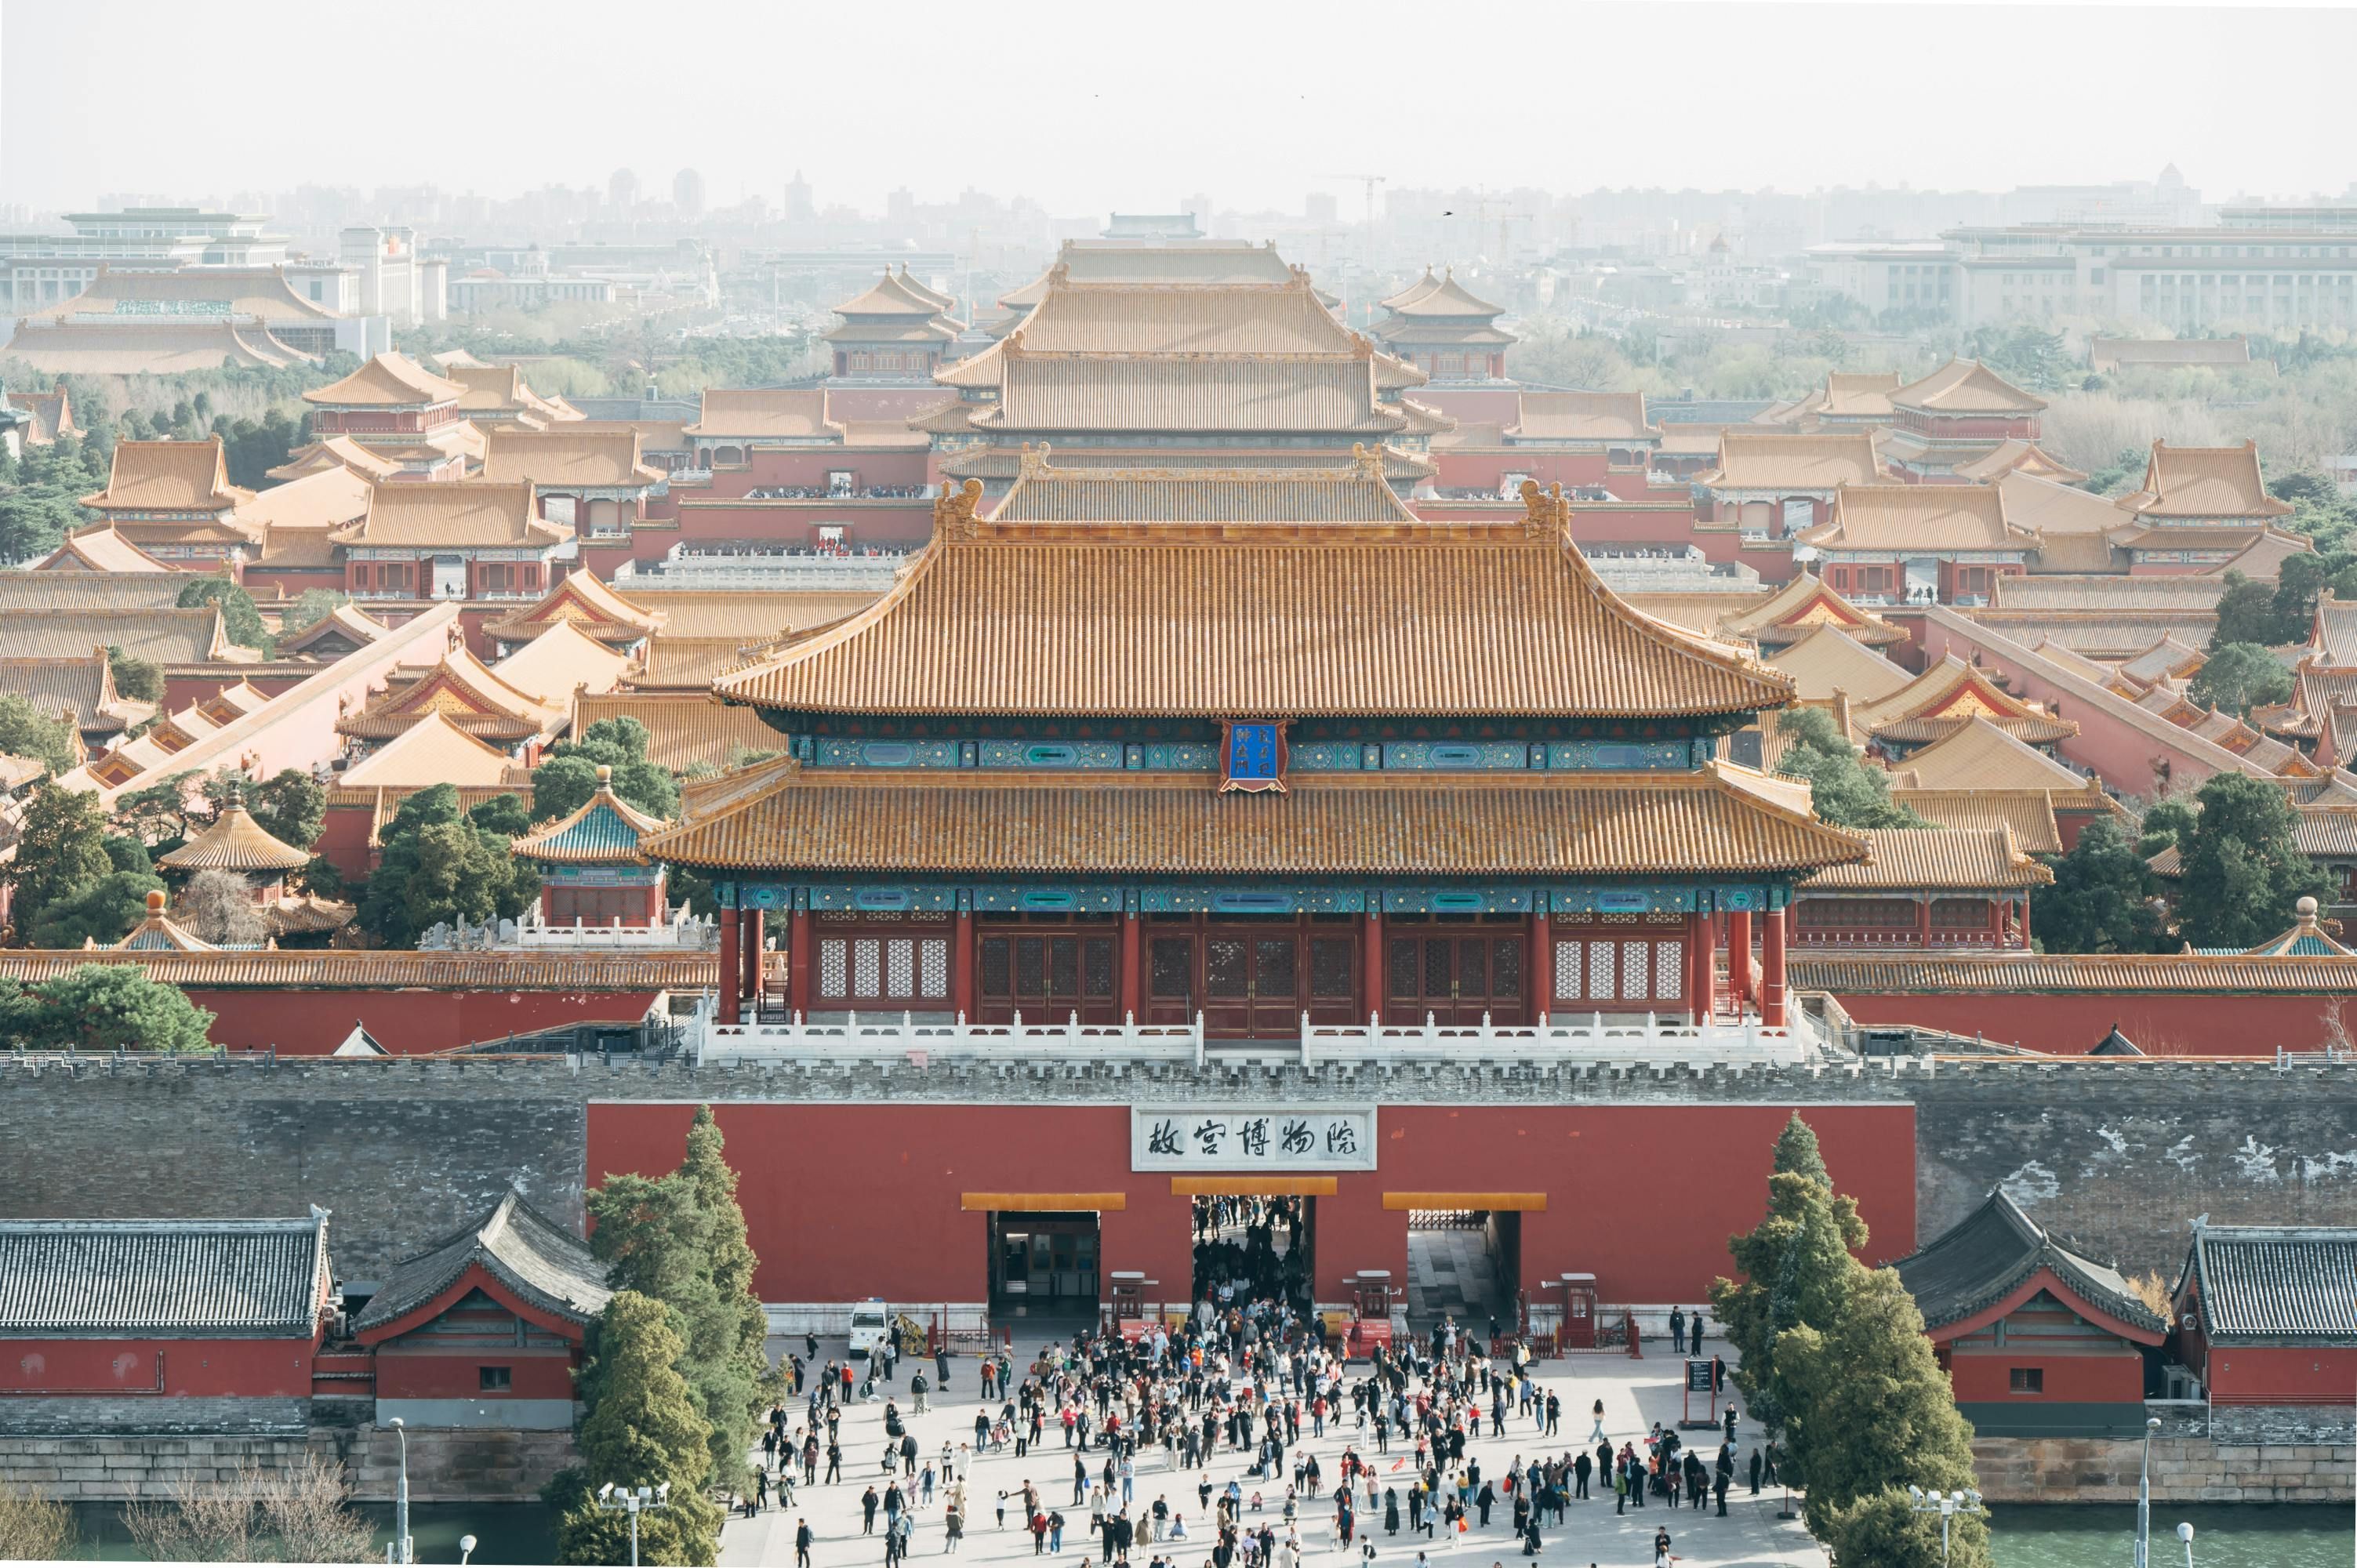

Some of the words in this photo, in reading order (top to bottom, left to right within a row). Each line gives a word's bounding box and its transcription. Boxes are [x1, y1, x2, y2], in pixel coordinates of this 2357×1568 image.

[1148, 1118, 1357, 1156] 故宫博物院
